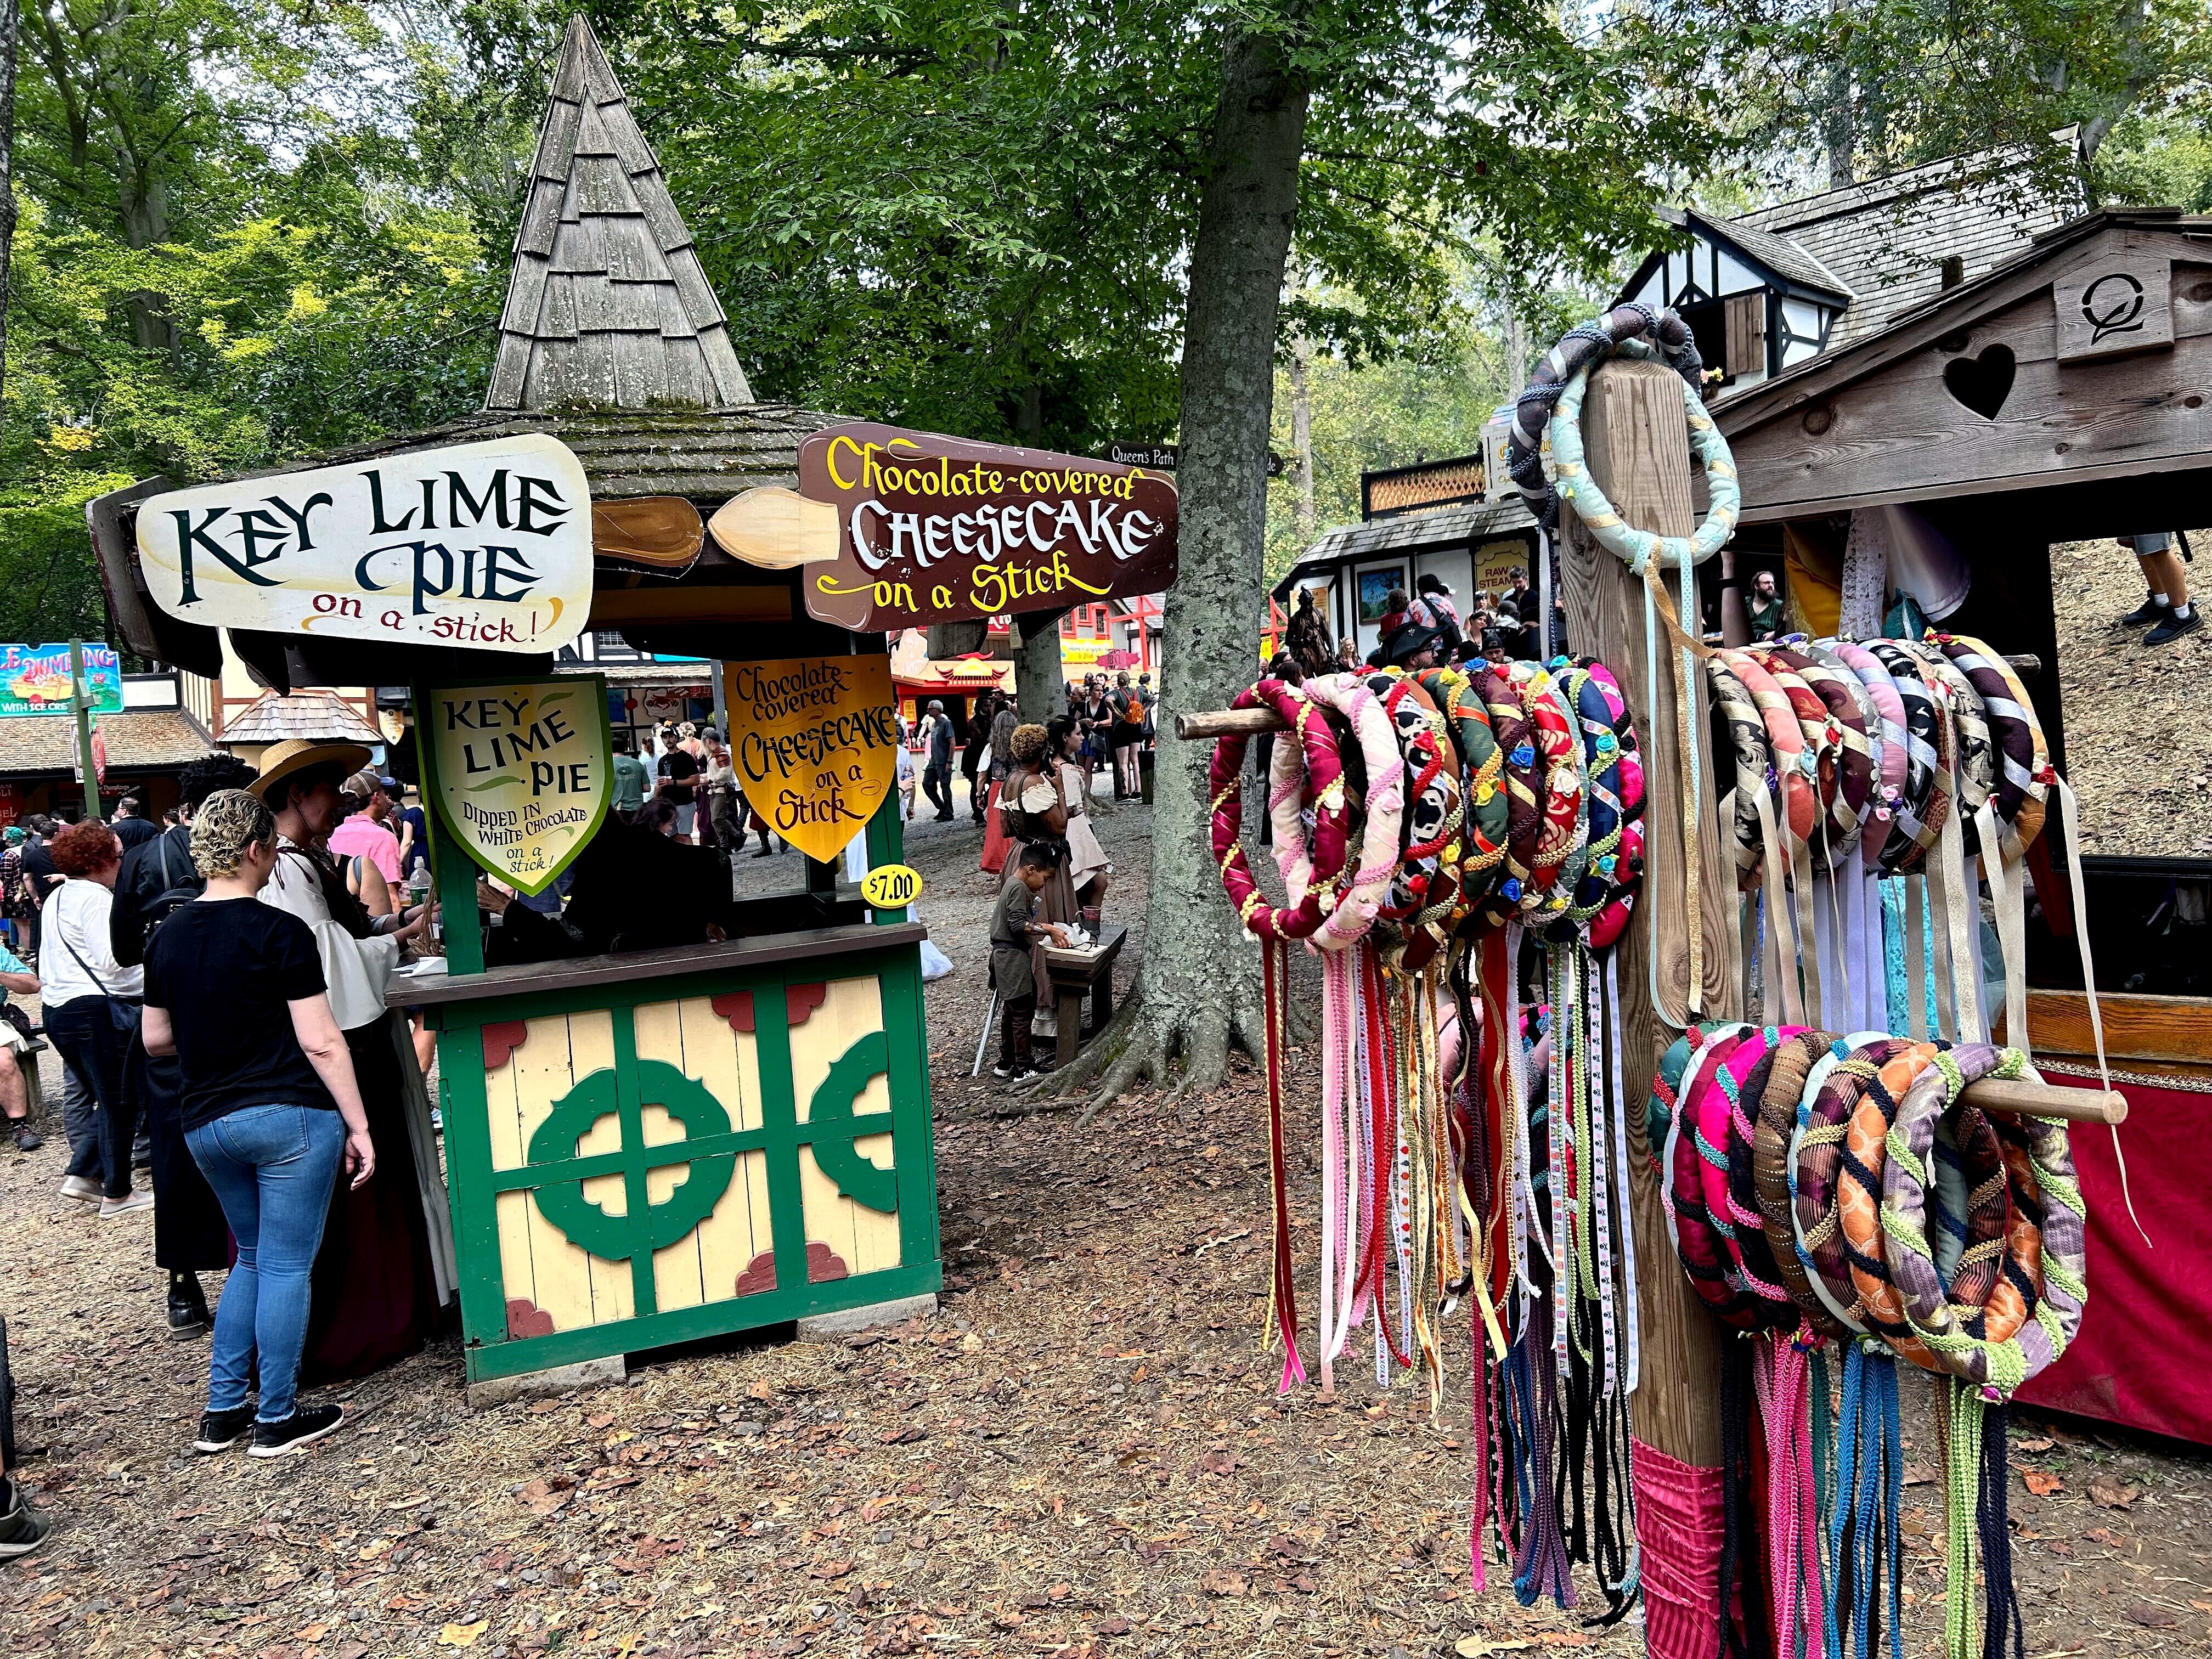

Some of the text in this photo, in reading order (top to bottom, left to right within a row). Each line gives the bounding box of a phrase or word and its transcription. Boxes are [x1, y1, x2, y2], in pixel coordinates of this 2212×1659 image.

[827, 436, 1146, 500] Chocolate-covered
[1112, 446, 1175, 465] Queen's Path
[163, 469, 572, 606] KEY LIME
[851, 498, 1157, 570] CHEESECAKE
[356, 540, 544, 614] PIE
[933, 585, 955, 609] a
[970, 550, 1113, 612] Stick
[1485, 566, 1509, 578] RAW
[313, 594, 361, 619] on
[381, 610, 407, 630] a
[22, 647, 115, 682] DUMING
[1, 702, 67, 713] WITH ICE CRE
[443, 698, 529, 730] KEY
[752, 682, 851, 721] covered
[463, 709, 575, 774] LIME
[741, 706, 895, 783] CHEESECAKE
[530, 761, 591, 795] PIE
[816, 765, 865, 789] on a
[461, 801, 541, 830] DIPPED IN
[477, 806, 588, 846] WHITE CHOCOLATE
[775, 788, 866, 831] Stick
[506, 847, 542, 859] on a
[510, 855, 554, 873] stick!
[870, 873, 913, 901] $7.00
